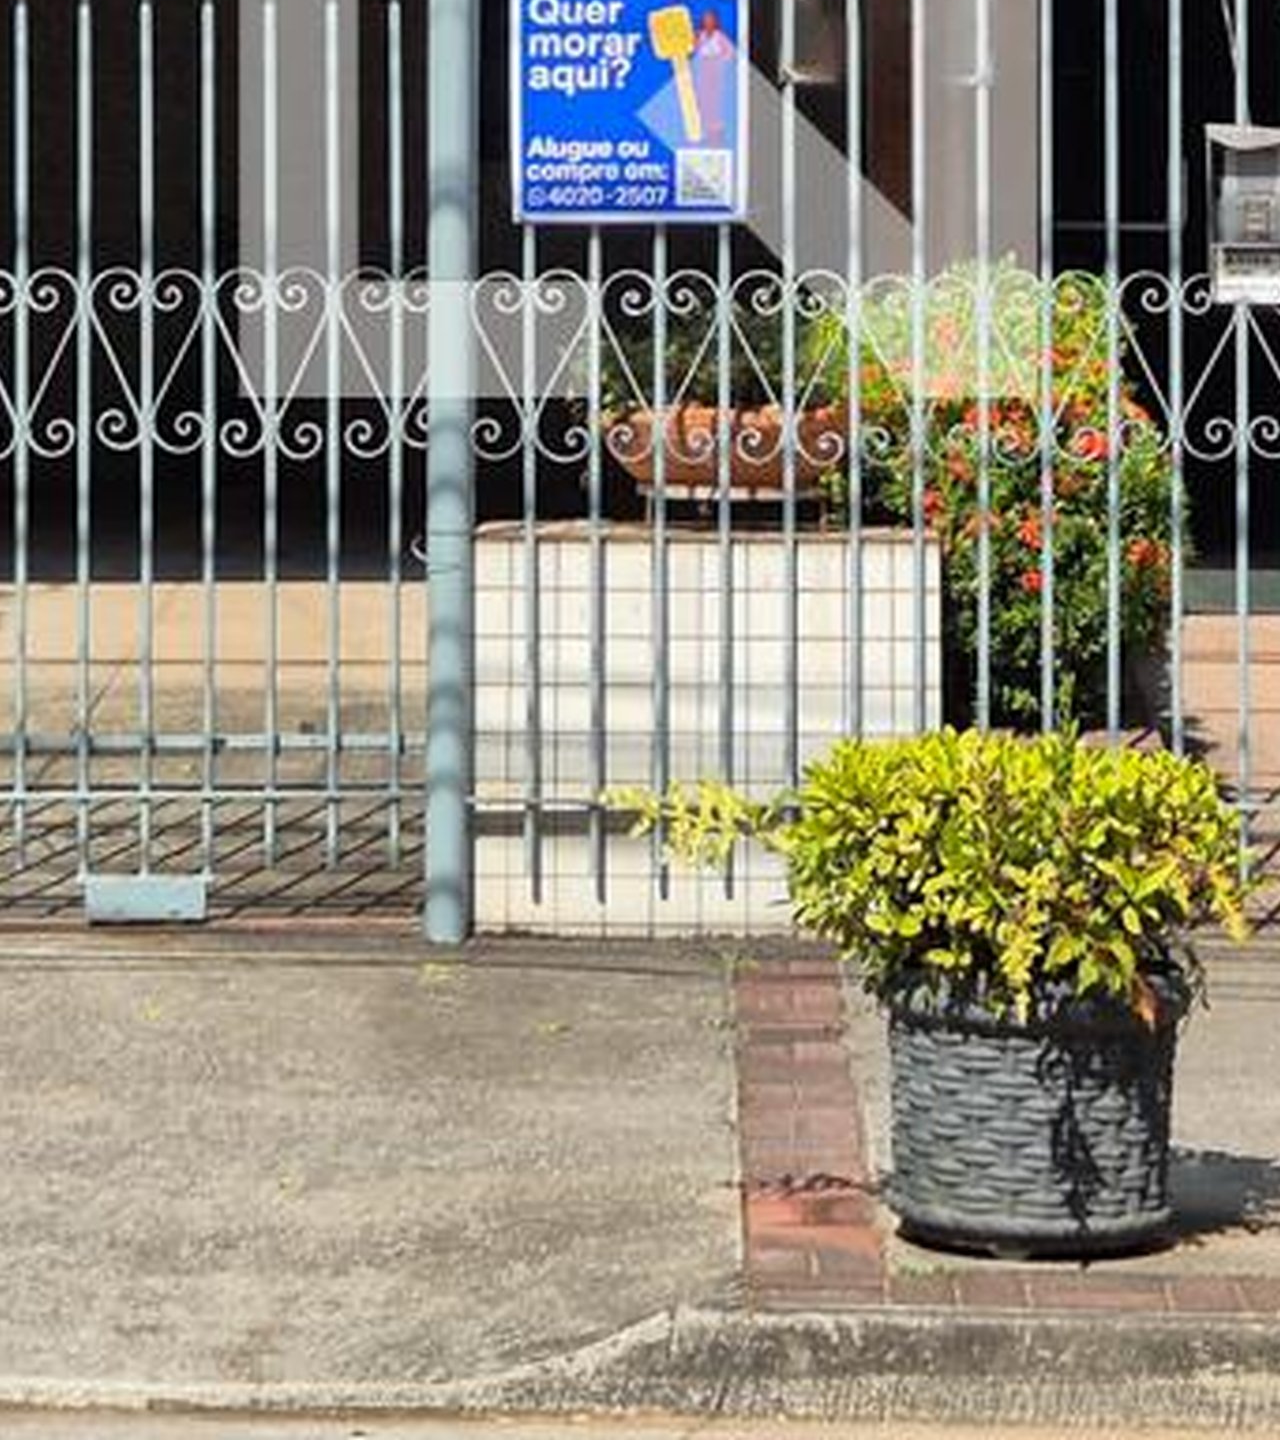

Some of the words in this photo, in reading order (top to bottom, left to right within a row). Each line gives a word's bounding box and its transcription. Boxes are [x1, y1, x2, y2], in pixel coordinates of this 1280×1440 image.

[528, 31, 641, 58] morar
[528, 59, 632, 96] aqui?
[527, 137, 613, 162] Alugue
[618, 139, 649, 158] ou
[527, 163, 621, 184] compre
